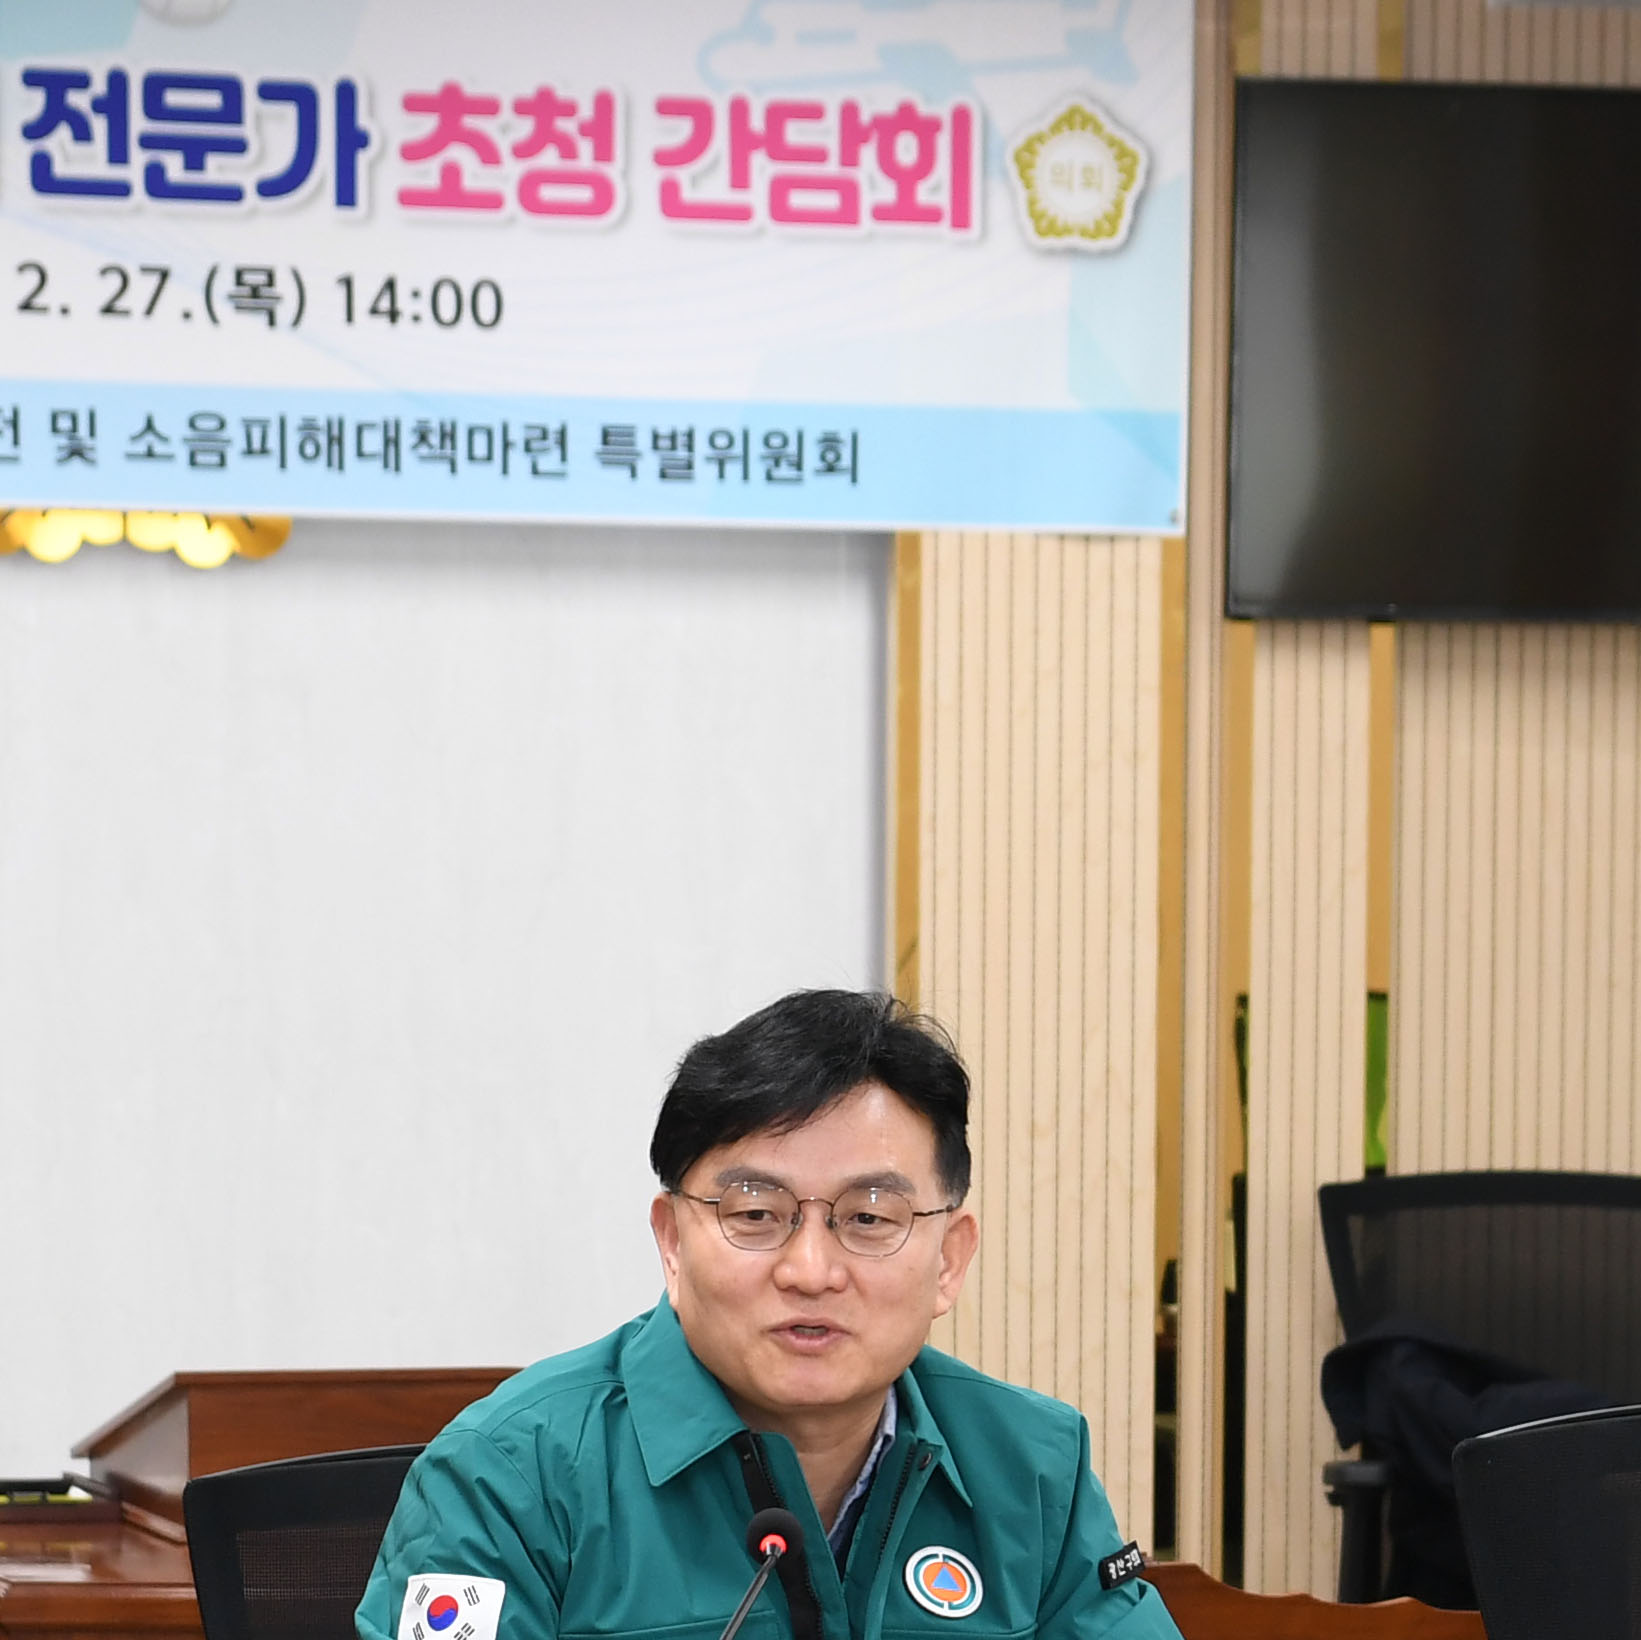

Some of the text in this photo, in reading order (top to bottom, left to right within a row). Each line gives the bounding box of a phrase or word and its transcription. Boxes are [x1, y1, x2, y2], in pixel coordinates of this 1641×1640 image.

[20, 68, 369, 207] 전문가
[398, 83, 616, 218] 초청
[654, 97, 972, 230] 간담회
[18, 262, 69, 315] 2.
[100, 265, 307, 330] 27.(목)
[337, 275, 503, 329] 14:00
[51, 409, 96, 465] 및
[126, 413, 567, 478] 소음피해대책마련
[595, 426, 858, 485] 특별위원회
